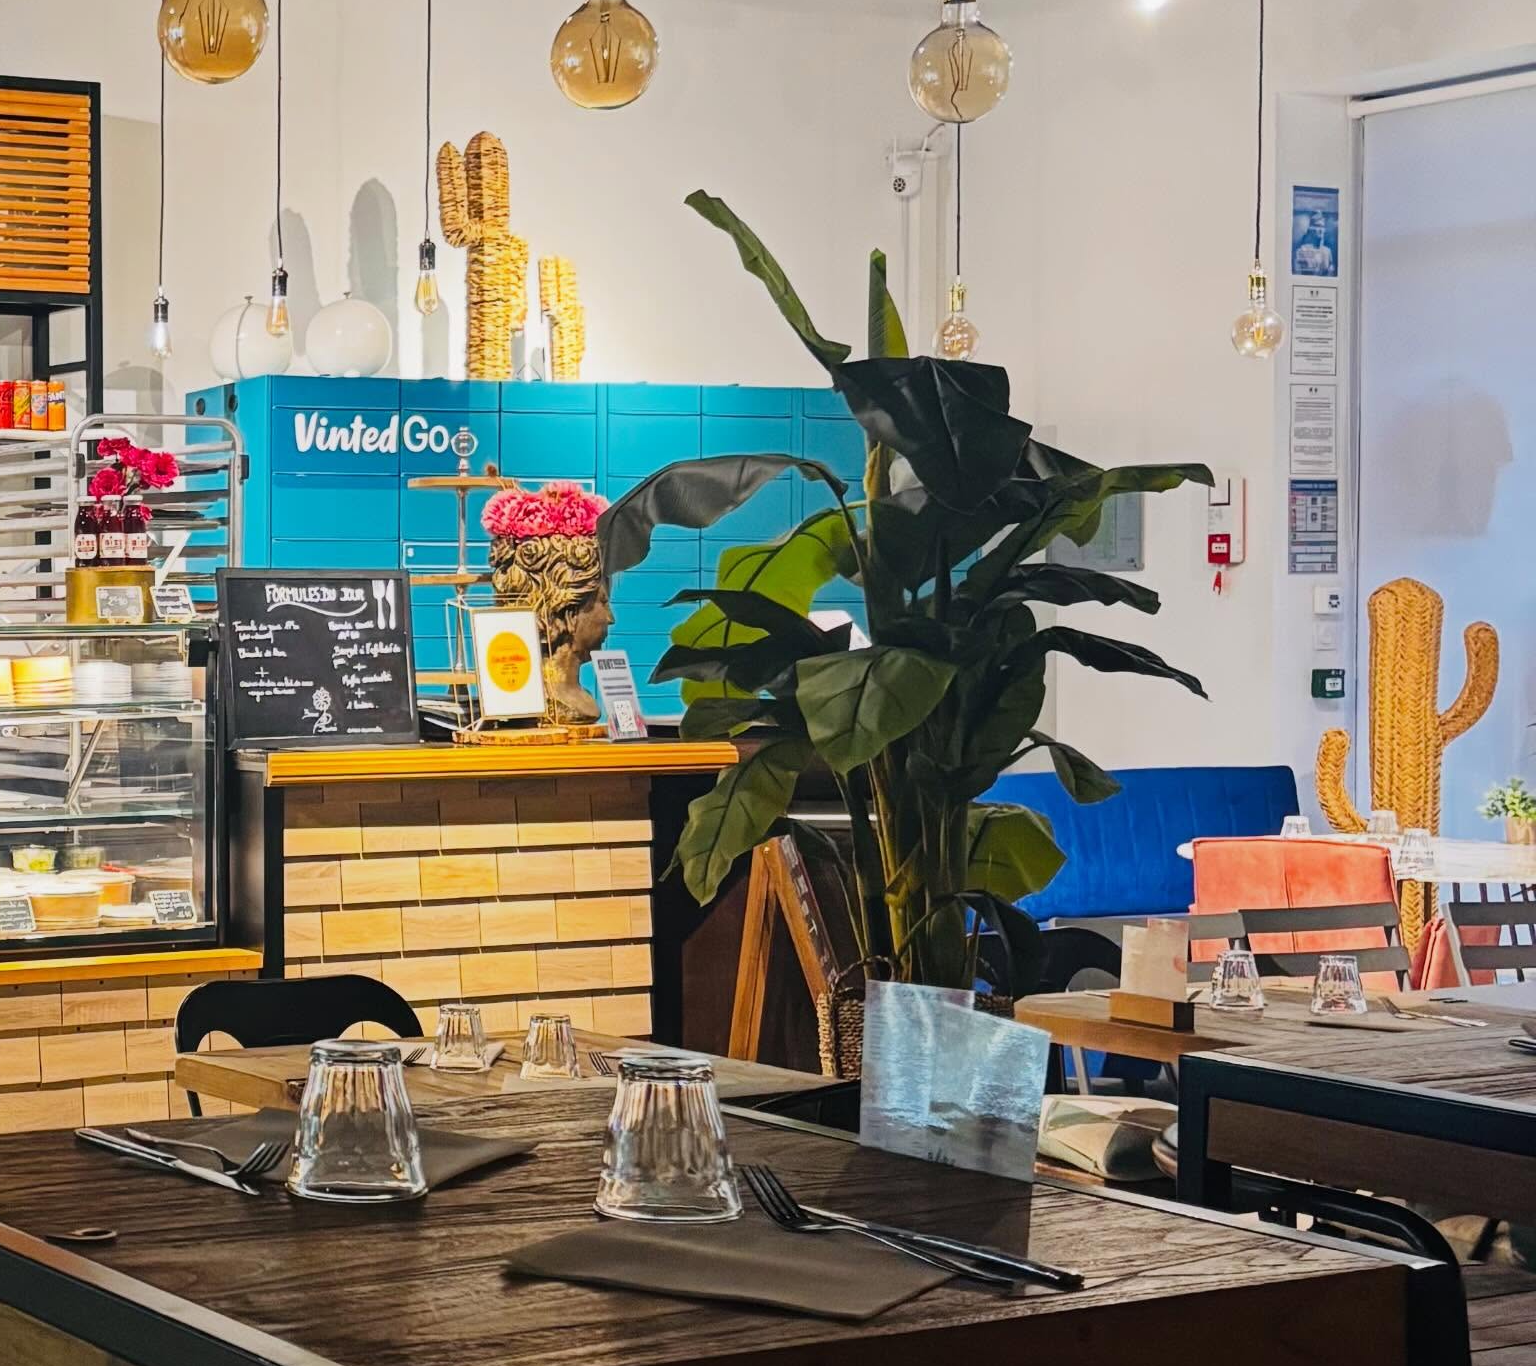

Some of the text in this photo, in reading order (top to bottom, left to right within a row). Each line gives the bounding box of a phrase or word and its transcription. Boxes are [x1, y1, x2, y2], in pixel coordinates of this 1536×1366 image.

[294, 411, 449, 454] Vinted Go
[265, 584, 320, 603] FORMULES
[340, 588, 365, 602] JOUR
